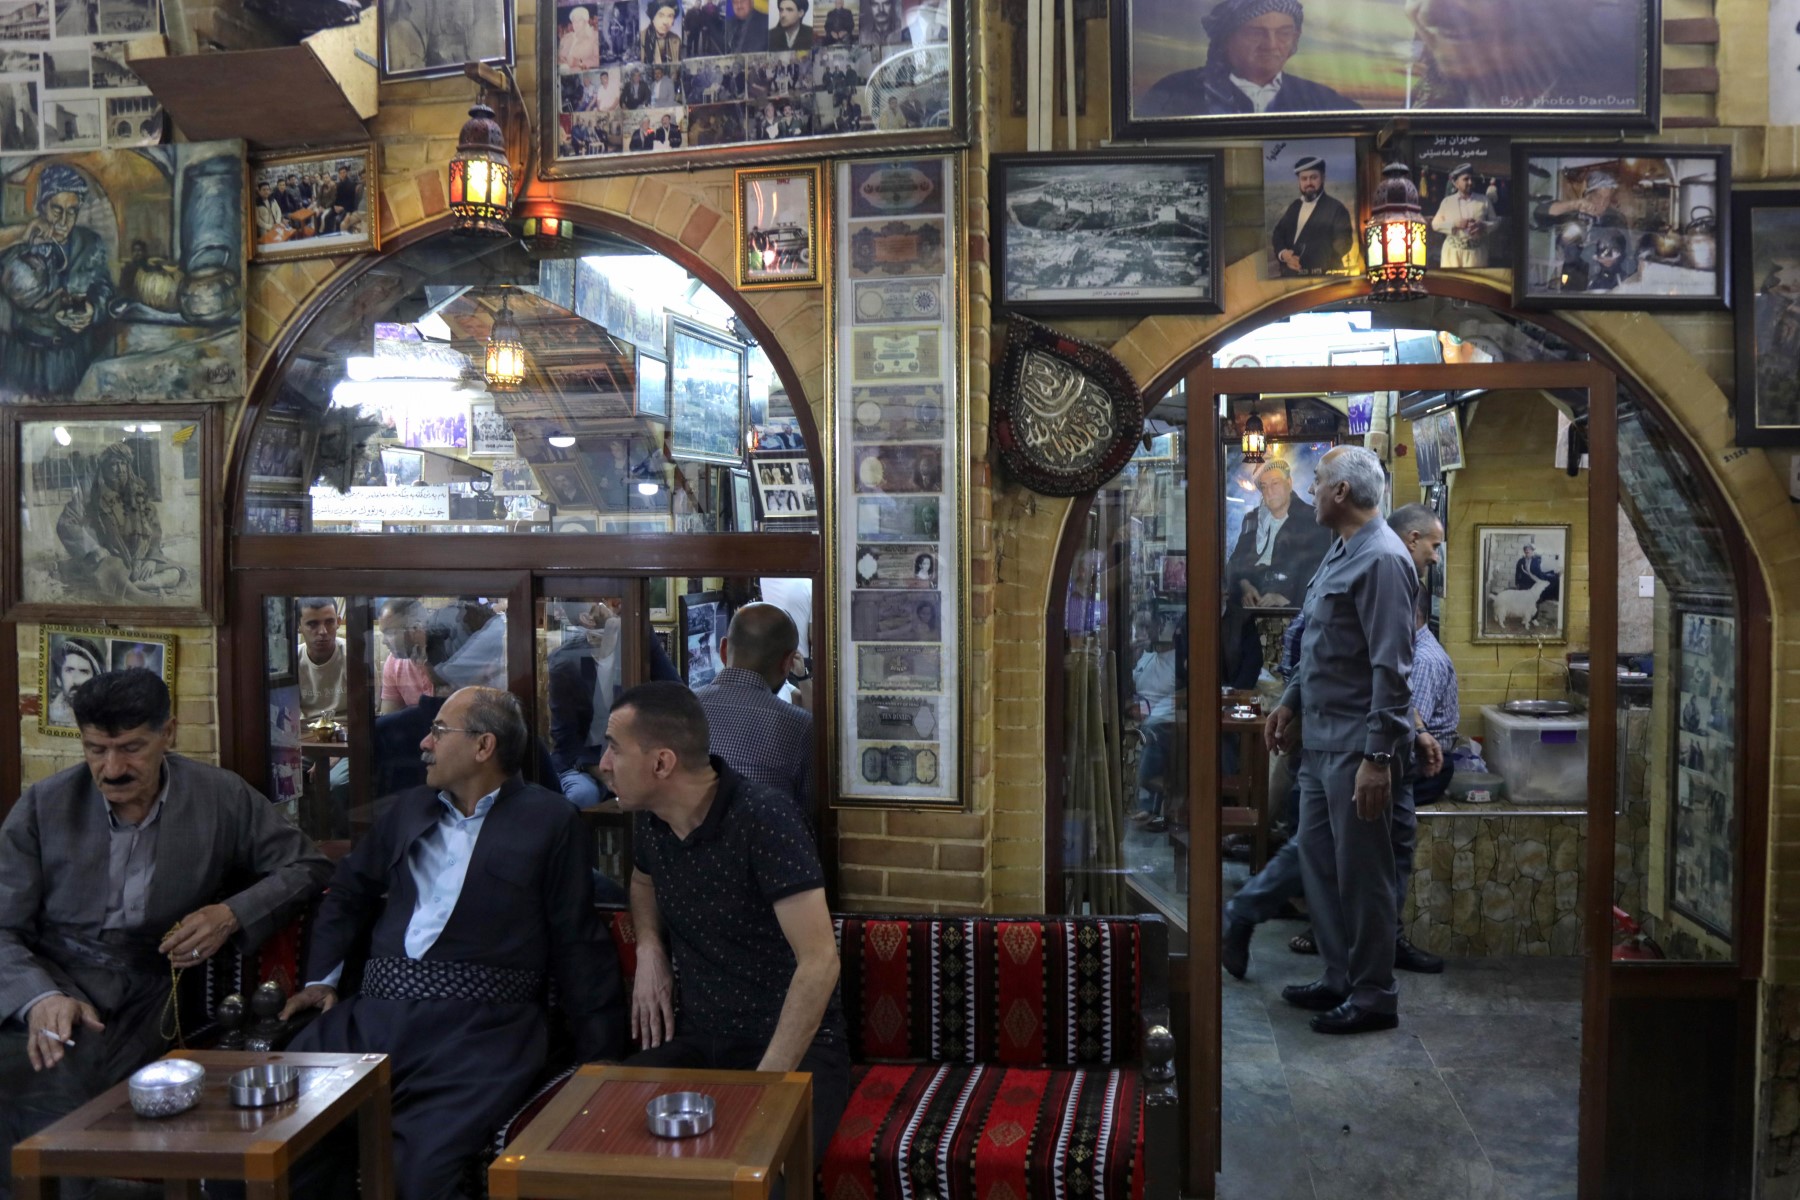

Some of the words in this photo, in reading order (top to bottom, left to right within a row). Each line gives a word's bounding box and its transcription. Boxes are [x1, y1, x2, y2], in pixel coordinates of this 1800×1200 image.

[1500, 95, 1524, 108] By:
[1532, 95, 1575, 108] photo
[1579, 95, 1636, 106] DanDun
